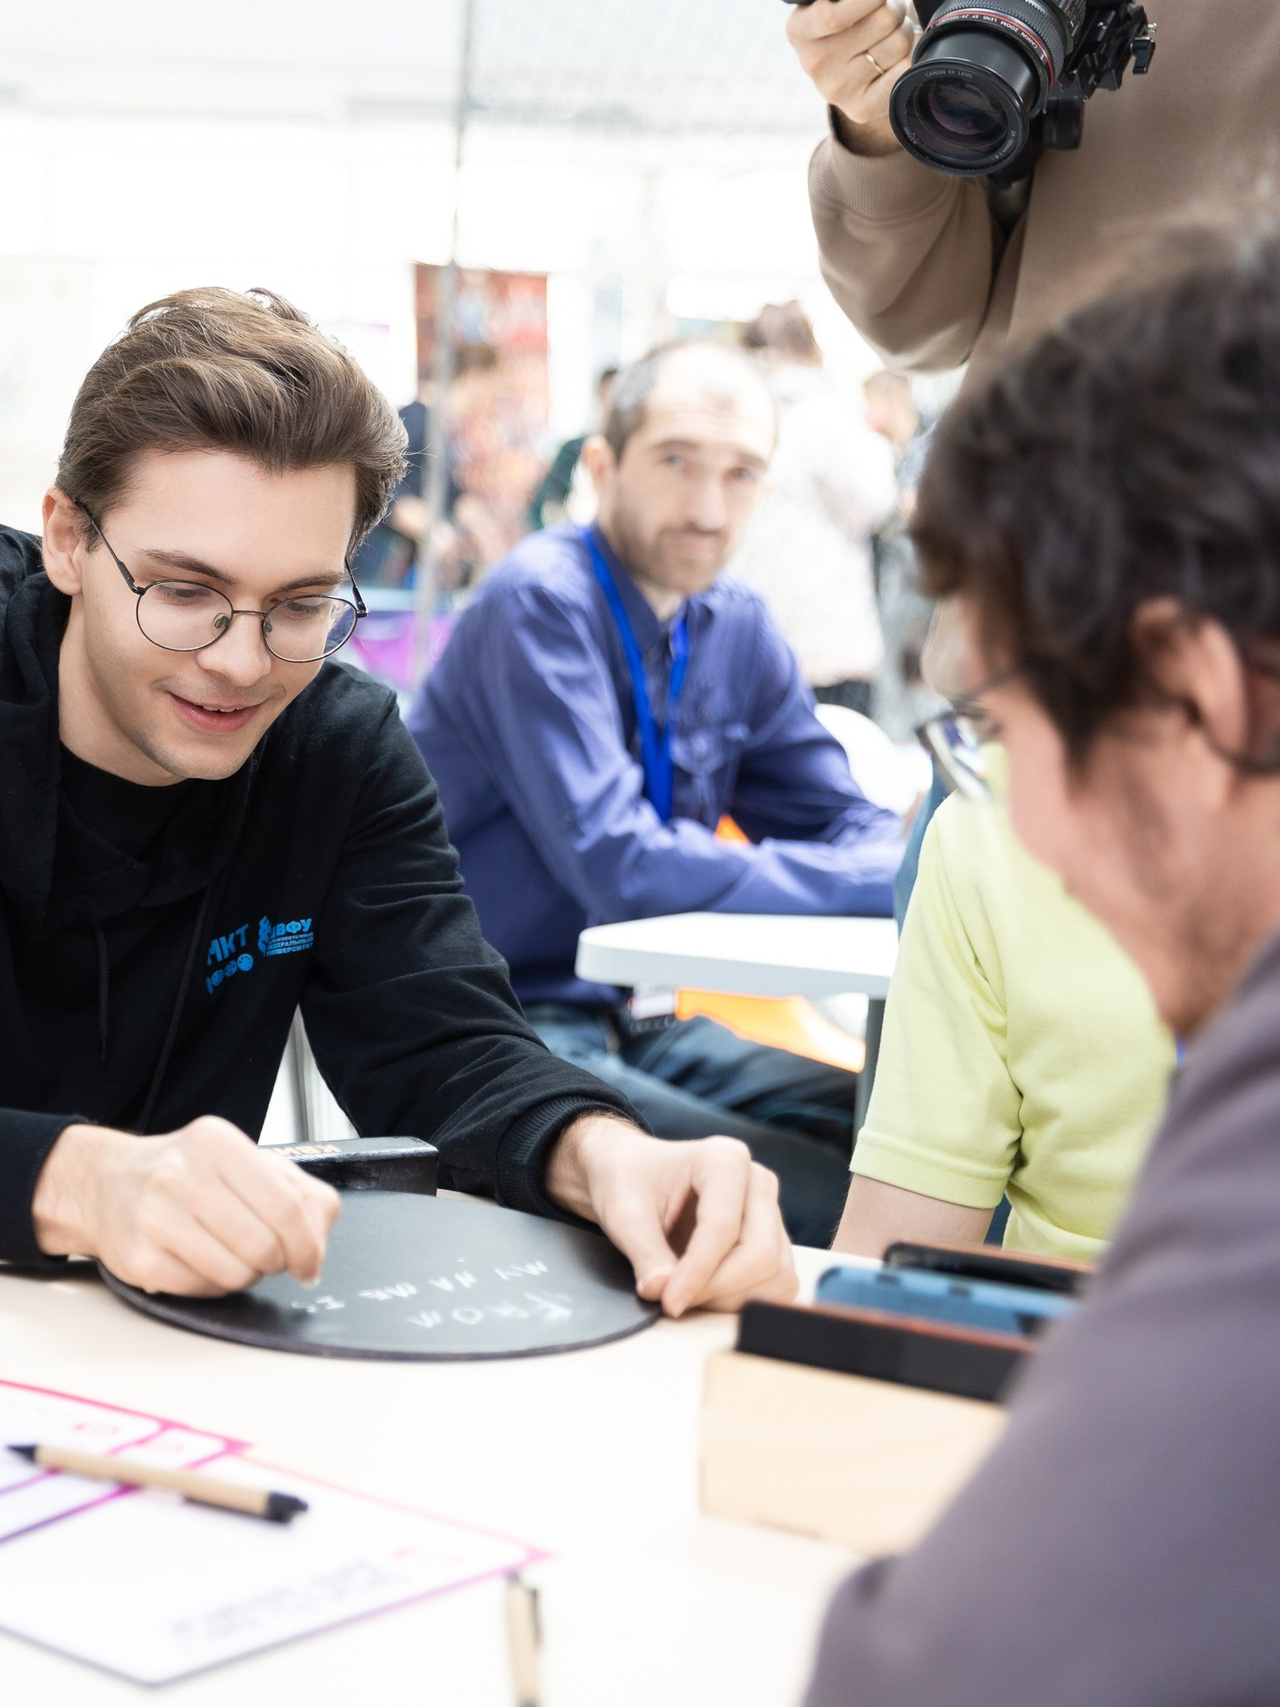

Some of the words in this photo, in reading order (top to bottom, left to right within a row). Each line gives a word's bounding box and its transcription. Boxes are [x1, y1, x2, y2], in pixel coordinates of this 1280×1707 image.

[982, 14, 998, 23] LENS
[999, 20, 1019, 33] ZOOM
[1020, 31, 1039, 50] CANON
[924, 68, 946, 79] CANON
[958, 69, 973, 80] LENS
